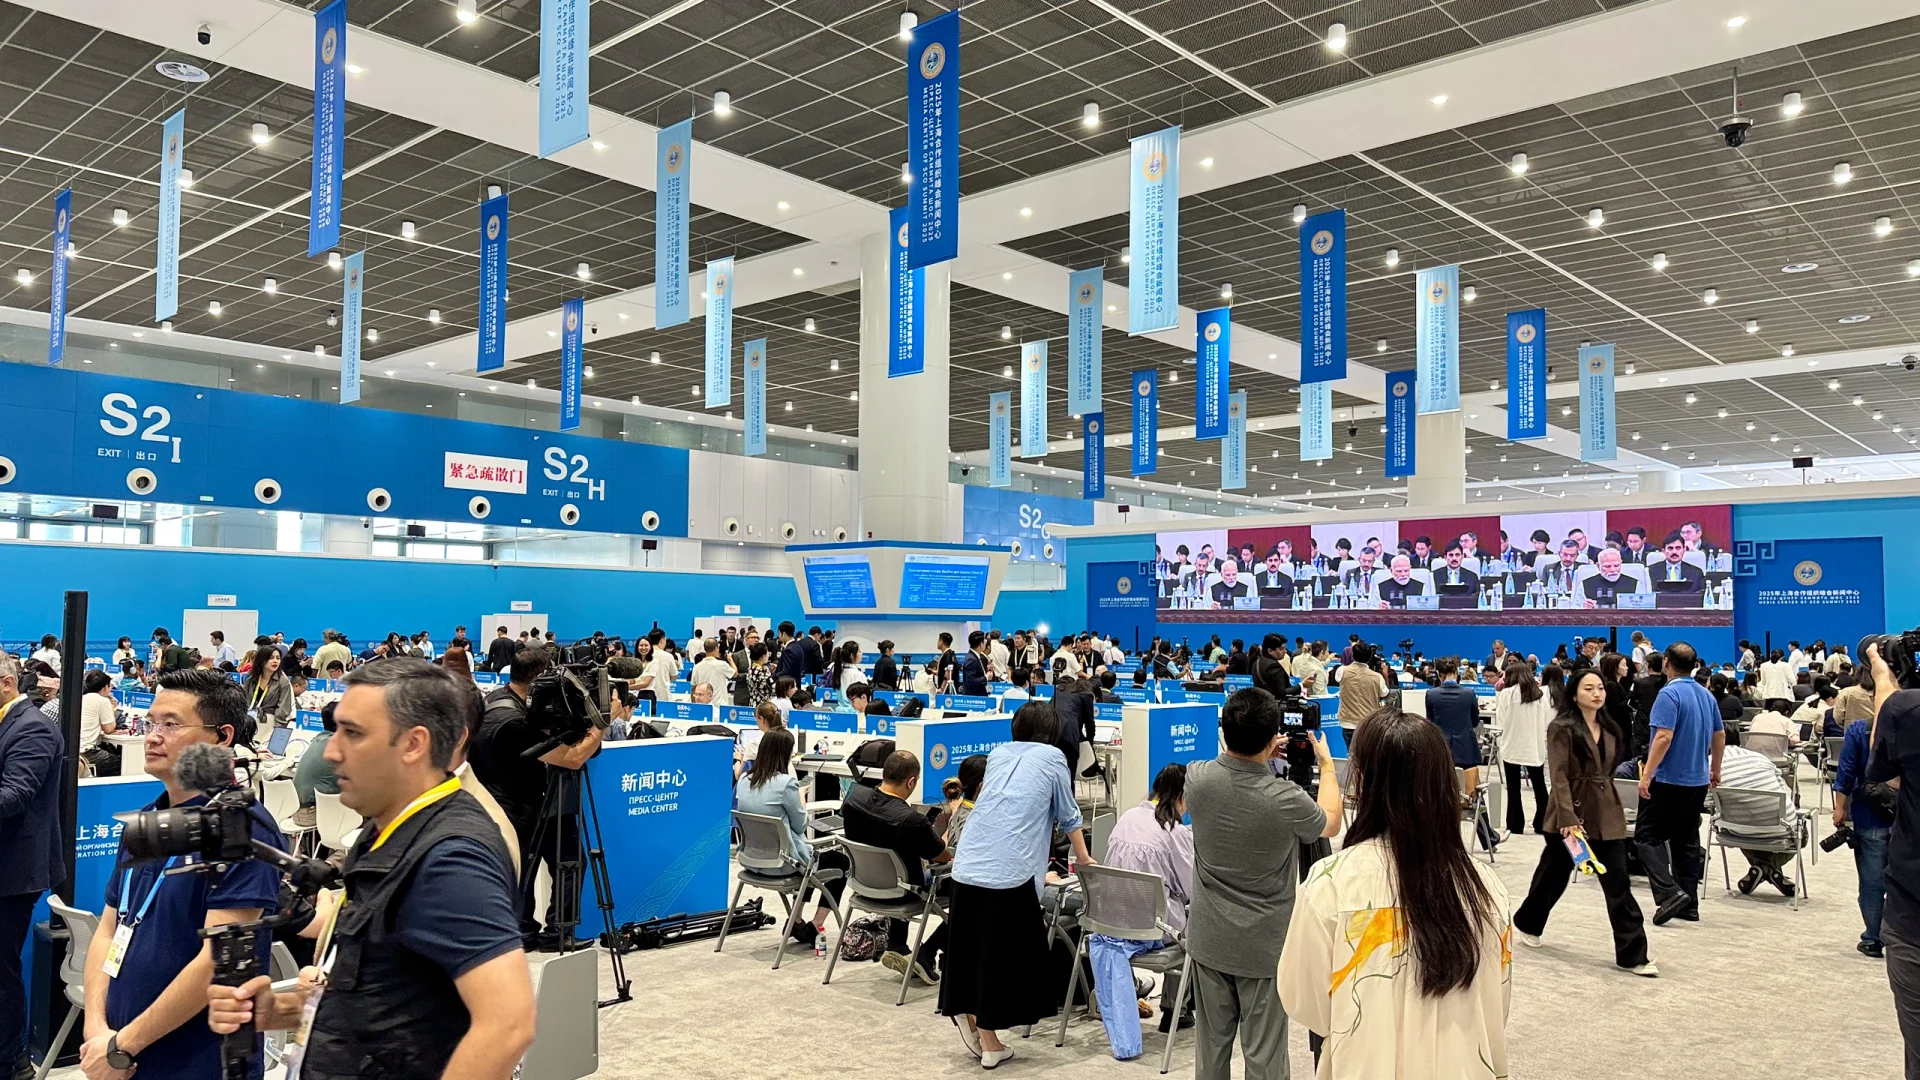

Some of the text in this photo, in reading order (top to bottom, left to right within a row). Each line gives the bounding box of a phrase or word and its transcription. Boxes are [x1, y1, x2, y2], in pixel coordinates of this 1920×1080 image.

[923, 153, 928, 163] OF
[98, 448, 156, 461] EXIT 出口
[450, 462, 522, 484] 紧急疏散门
[1171, 723, 1199, 737] 新闻中心
[621, 769, 687, 792] 新闻中心
[629, 792, 679, 804] ПРЕСС-ЦЕНТР
[628, 803, 678, 816] MEDIA CENTER
